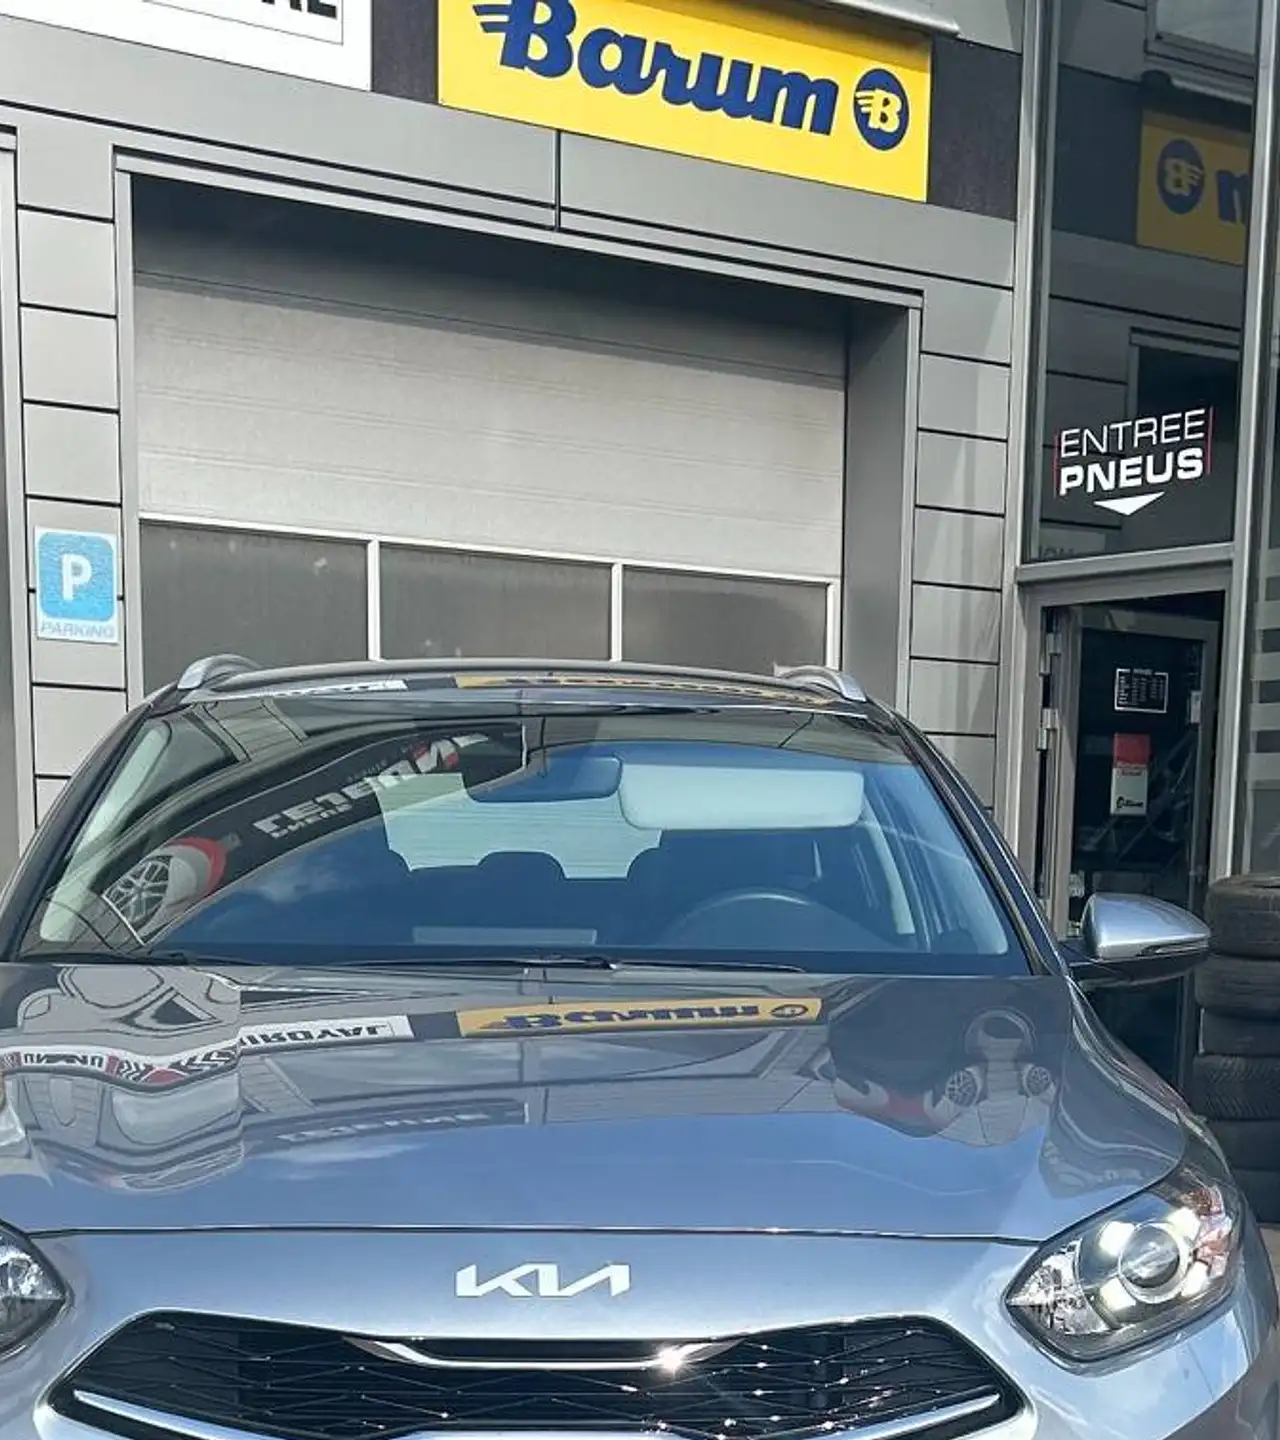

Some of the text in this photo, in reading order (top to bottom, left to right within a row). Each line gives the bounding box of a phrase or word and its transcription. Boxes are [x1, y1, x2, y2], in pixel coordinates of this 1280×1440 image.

[473, 0, 840, 135] Barum
[1060, 409, 1205, 458] ENTREE
[1059, 447, 1203, 496] PNEUS
[62, 553, 92, 601] P
[40, 620, 116, 638] PARKING
[455, 1262, 631, 1297] KIA
